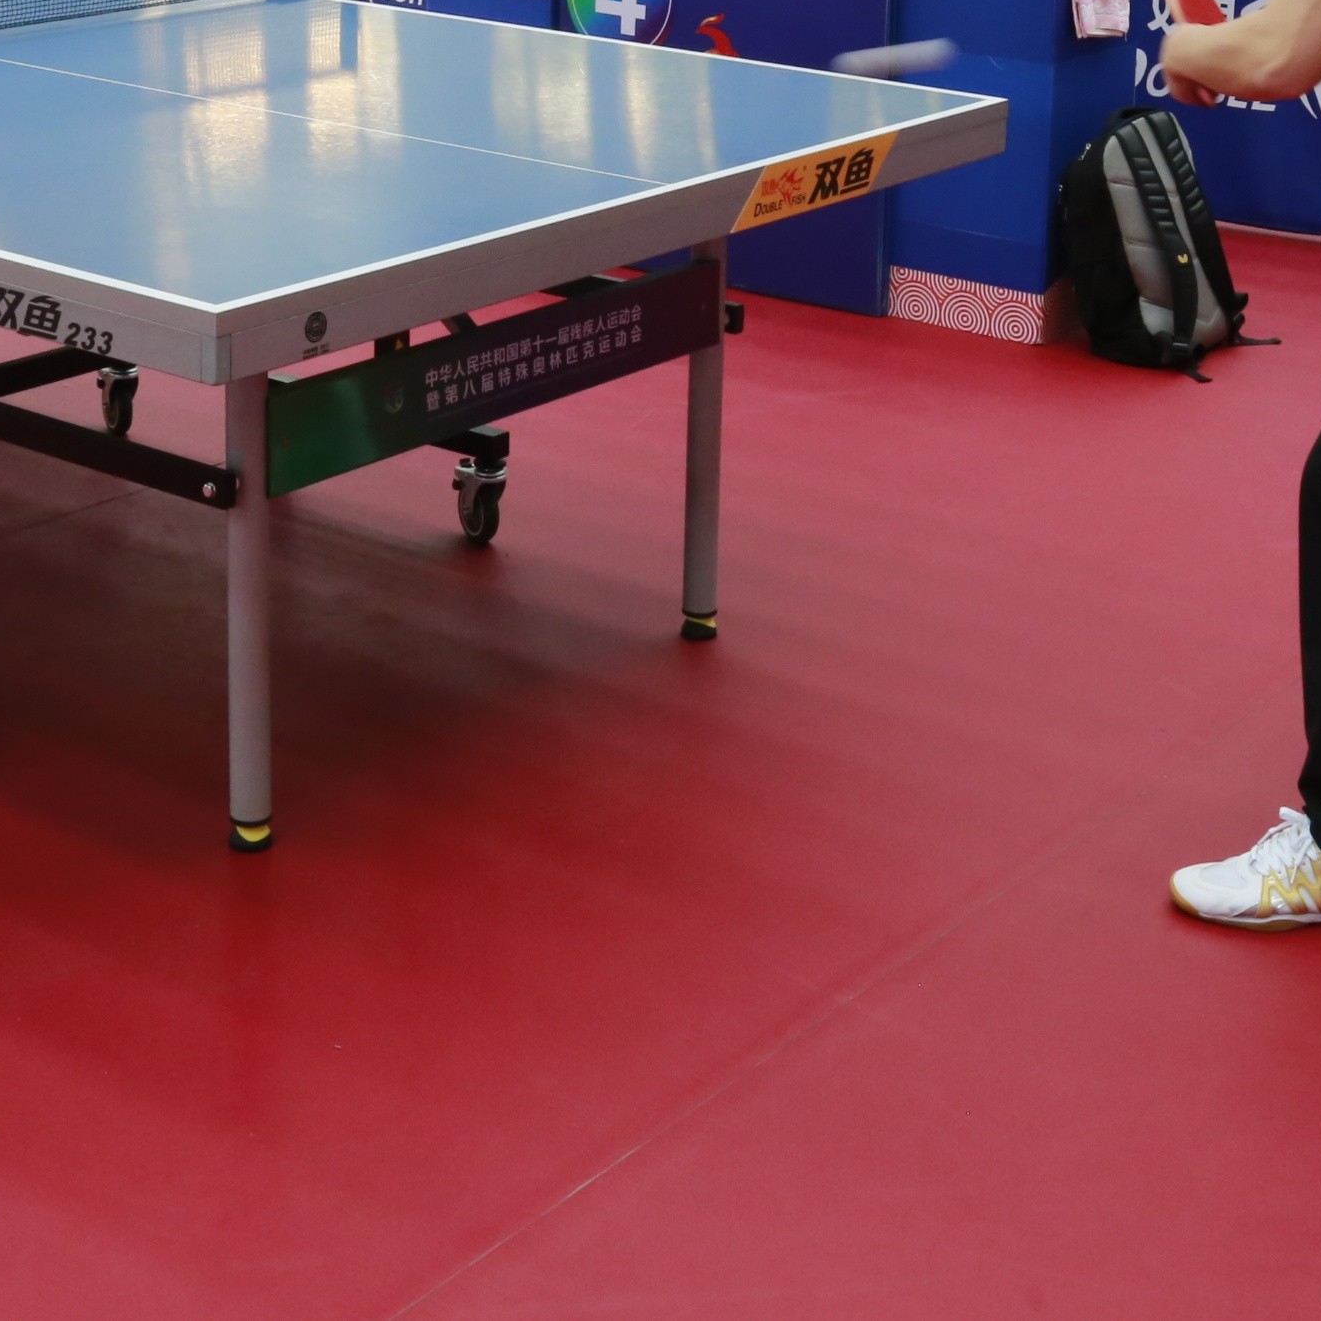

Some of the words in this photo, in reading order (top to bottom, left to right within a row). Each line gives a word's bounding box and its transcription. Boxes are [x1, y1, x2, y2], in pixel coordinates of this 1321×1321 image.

[808, 147, 875, 205] 双鱼
[753, 199, 783, 218] DOUBLE
[65, 322, 114, 357] 233
